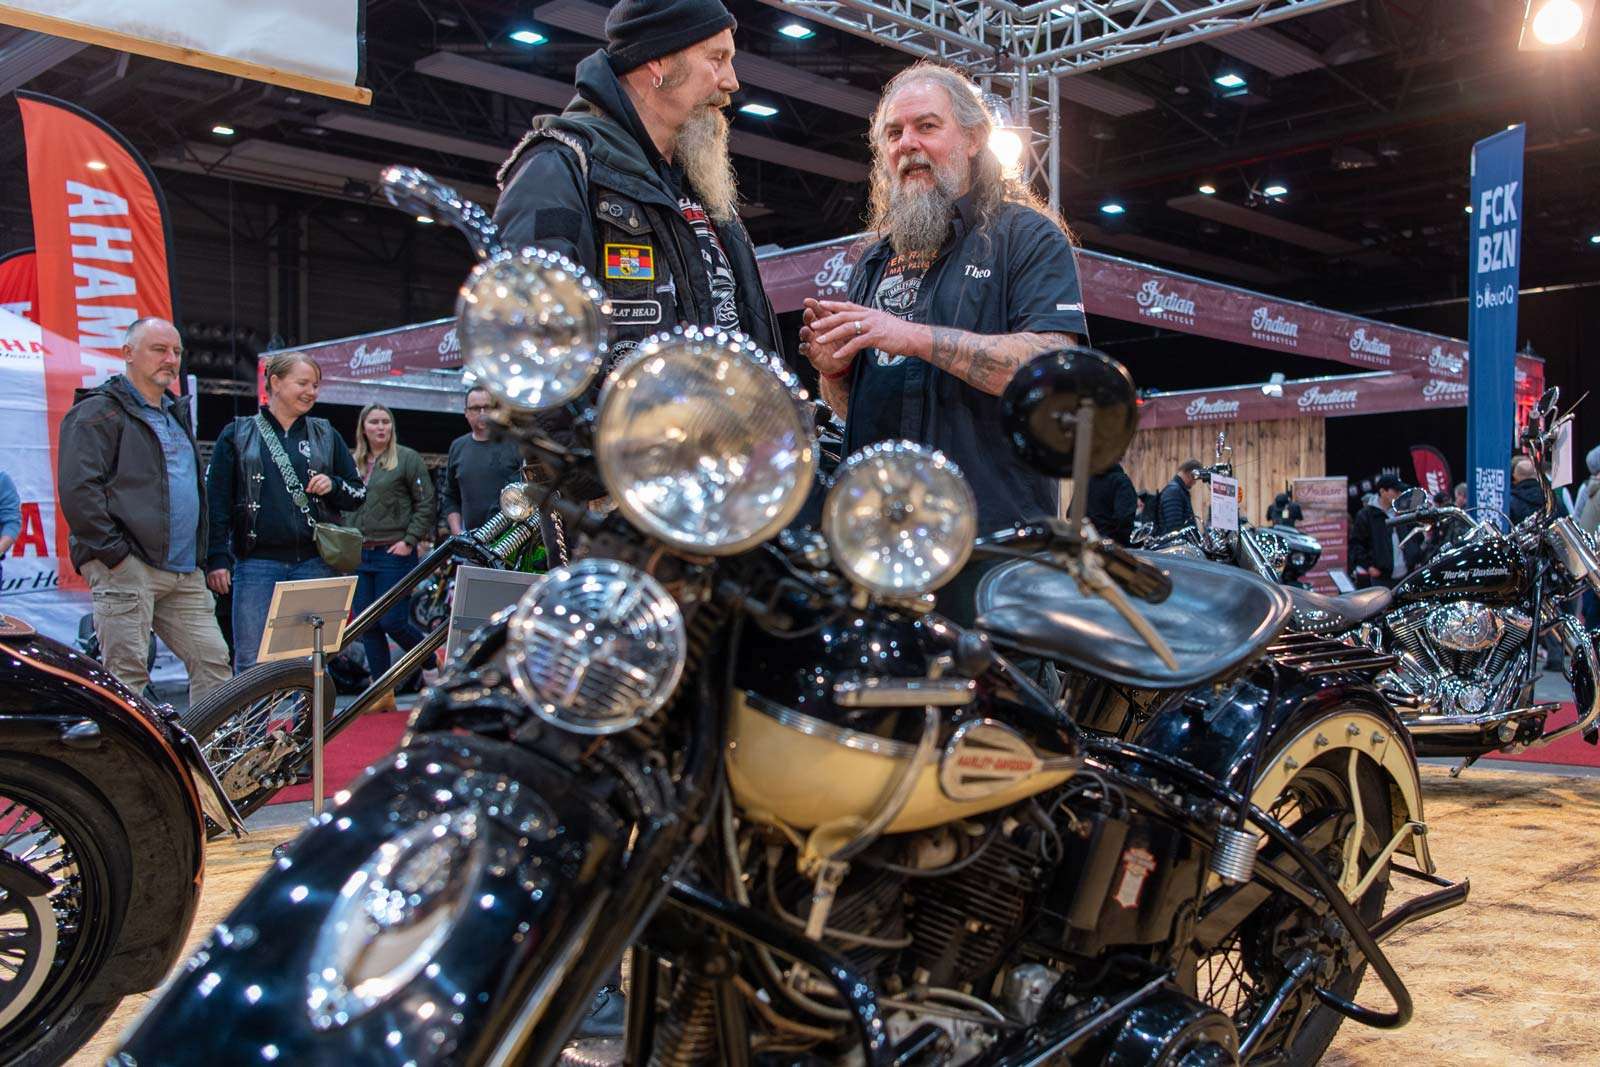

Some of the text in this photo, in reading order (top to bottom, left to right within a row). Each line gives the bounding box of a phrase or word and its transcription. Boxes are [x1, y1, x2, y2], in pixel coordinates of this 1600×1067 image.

[1480, 181, 1518, 229] FCK
[1477, 228, 1516, 273] BZN
[965, 264, 991, 279] Theo
[1136, 280, 1195, 316] Indian
[632, 308, 656, 317] HEAD
[1251, 307, 1299, 337] Indian
[1349, 328, 1391, 356] Indian
[349, 344, 392, 369] Indian
[1185, 397, 1240, 416] Indian
[1297, 386, 1358, 407] Indian
